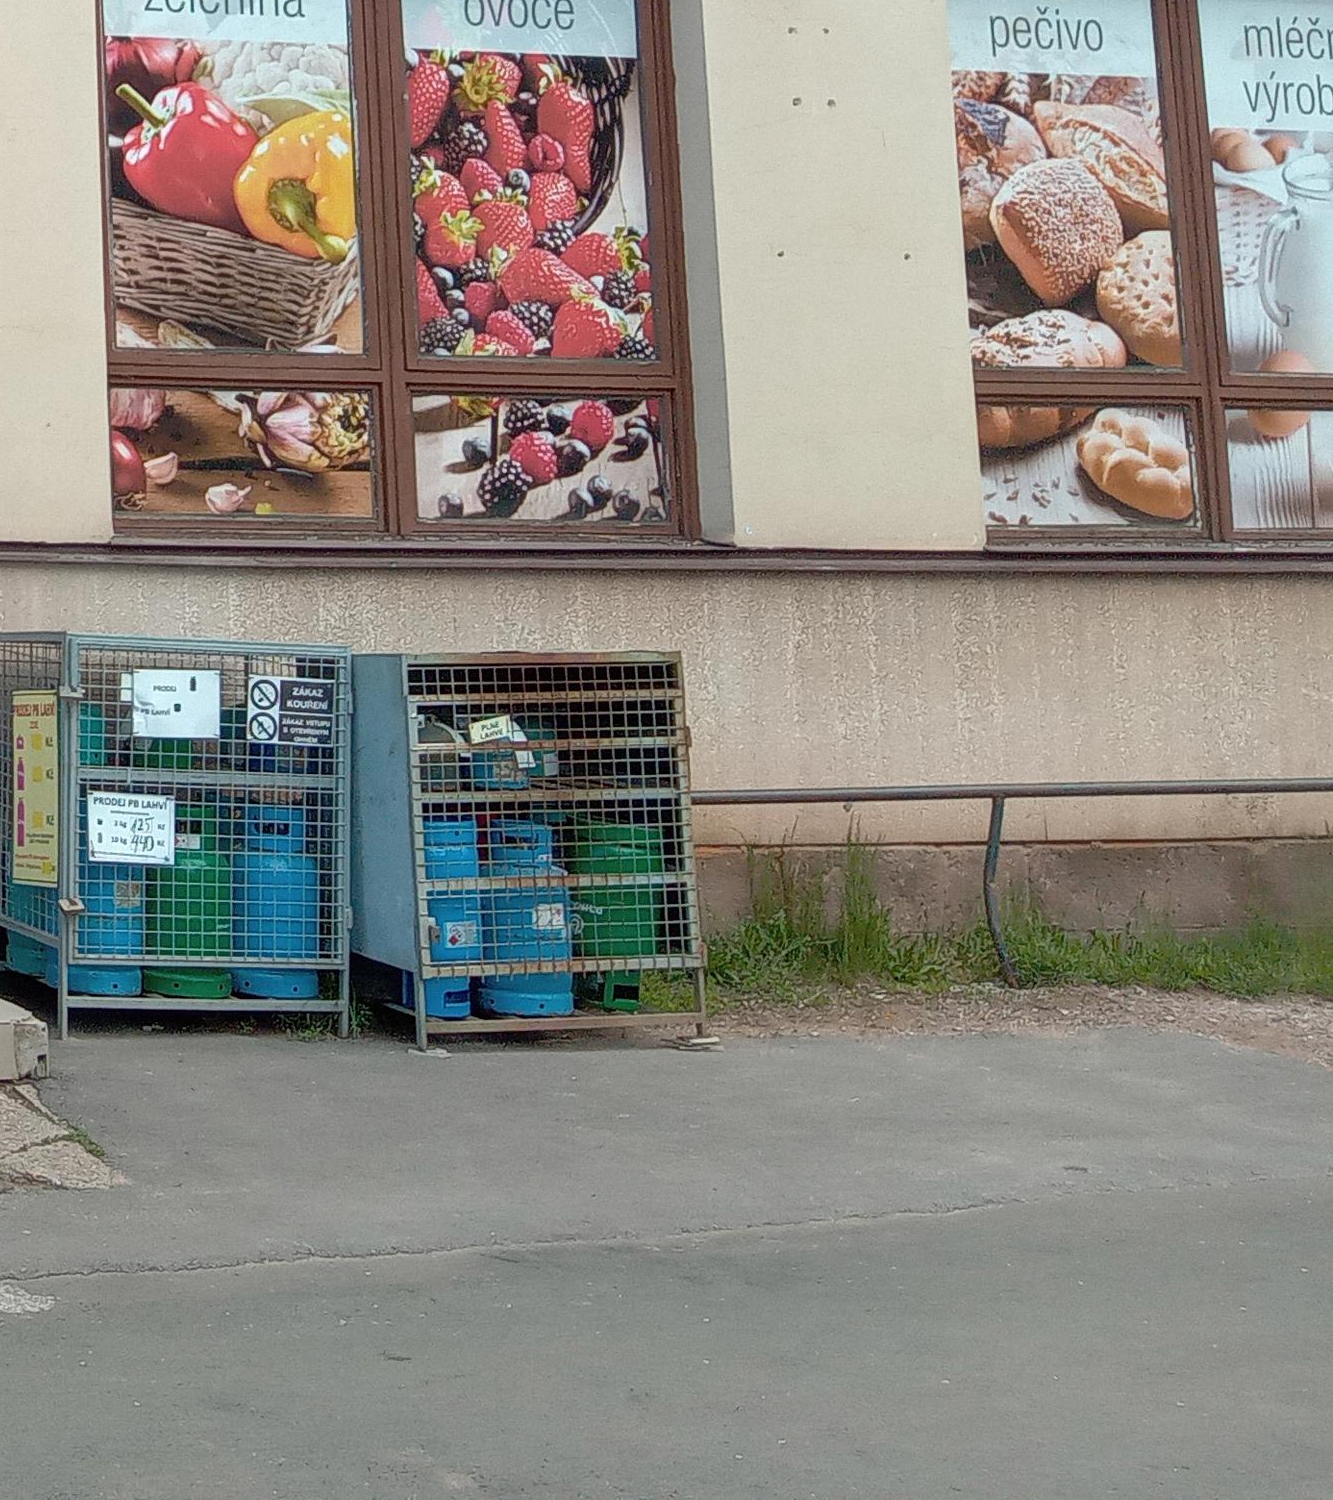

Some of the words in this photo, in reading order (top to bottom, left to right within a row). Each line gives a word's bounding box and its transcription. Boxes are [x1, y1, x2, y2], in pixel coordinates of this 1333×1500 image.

[989, 5, 1104, 57] pečivo
[291, 684, 325, 698] ZÁKAZ
[93, 796, 126, 808] PRODEJ
[127, 798, 140, 809] PB
[141, 800, 168, 811] LAHVÍ
